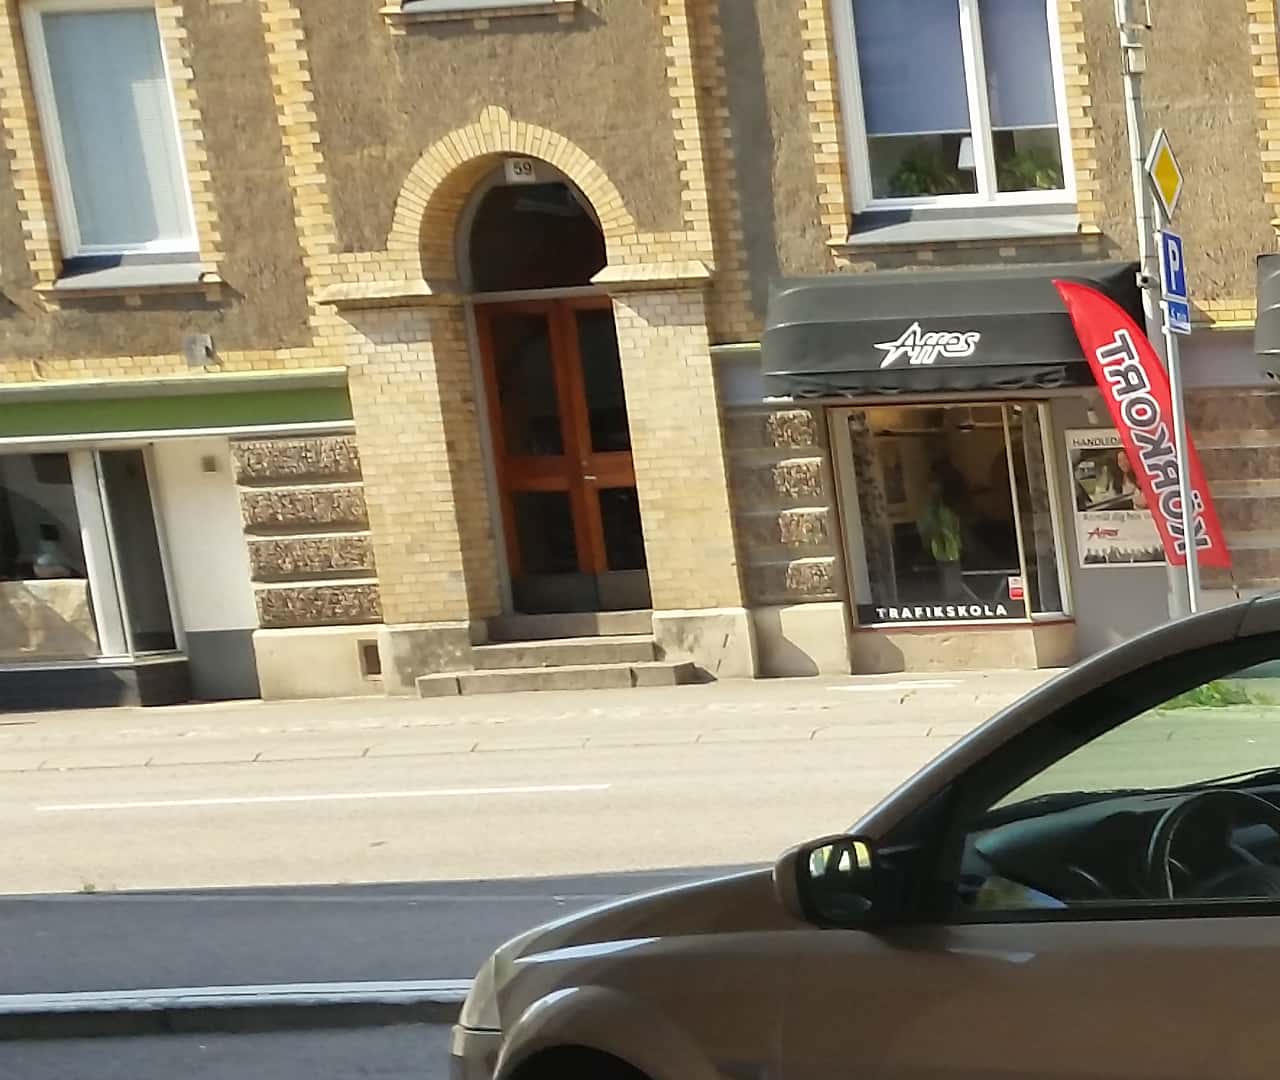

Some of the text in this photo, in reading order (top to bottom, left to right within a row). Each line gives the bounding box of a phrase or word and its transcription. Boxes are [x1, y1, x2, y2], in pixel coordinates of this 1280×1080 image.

[513, 160, 532, 176] 59
[1168, 239, 1180, 291] P
[872, 320, 982, 369] Affes
[1072, 437, 1122, 448] HANDLED
[875, 604, 1008, 620] TRAFIKSKOLA
